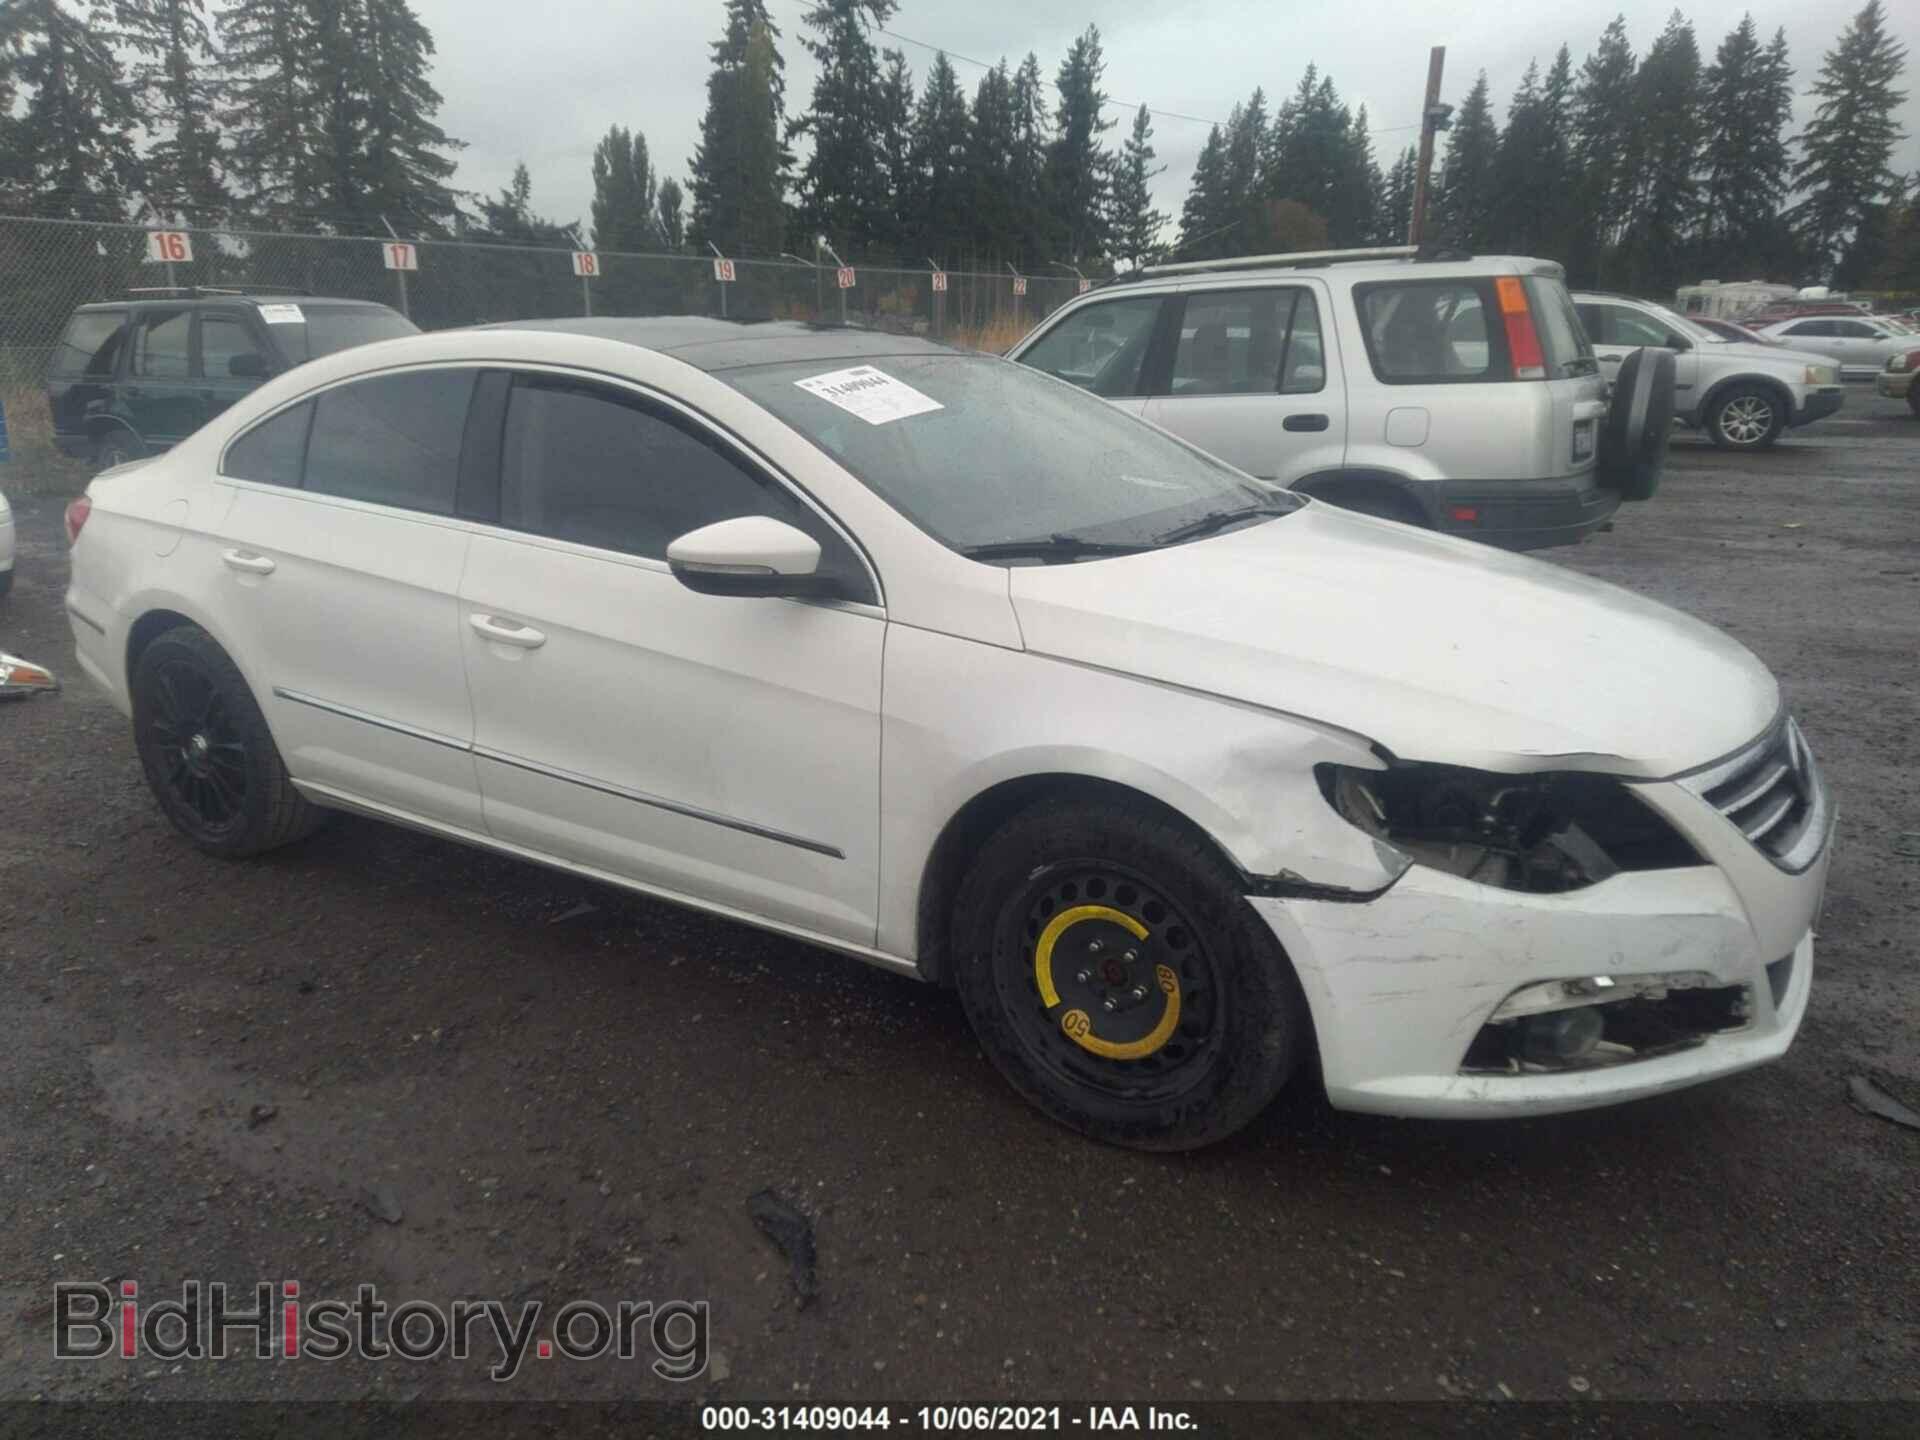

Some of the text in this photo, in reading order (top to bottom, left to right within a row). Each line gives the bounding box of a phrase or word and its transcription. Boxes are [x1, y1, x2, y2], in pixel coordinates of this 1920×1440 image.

[154, 233, 186, 259] 16
[390, 245, 409, 267] 17
[577, 254, 594, 273] 18
[717, 262, 732, 280] 19
[840, 269, 854, 286] 20
[934, 274, 945, 290] 21
[1064, 1011, 1089, 1038] 50
